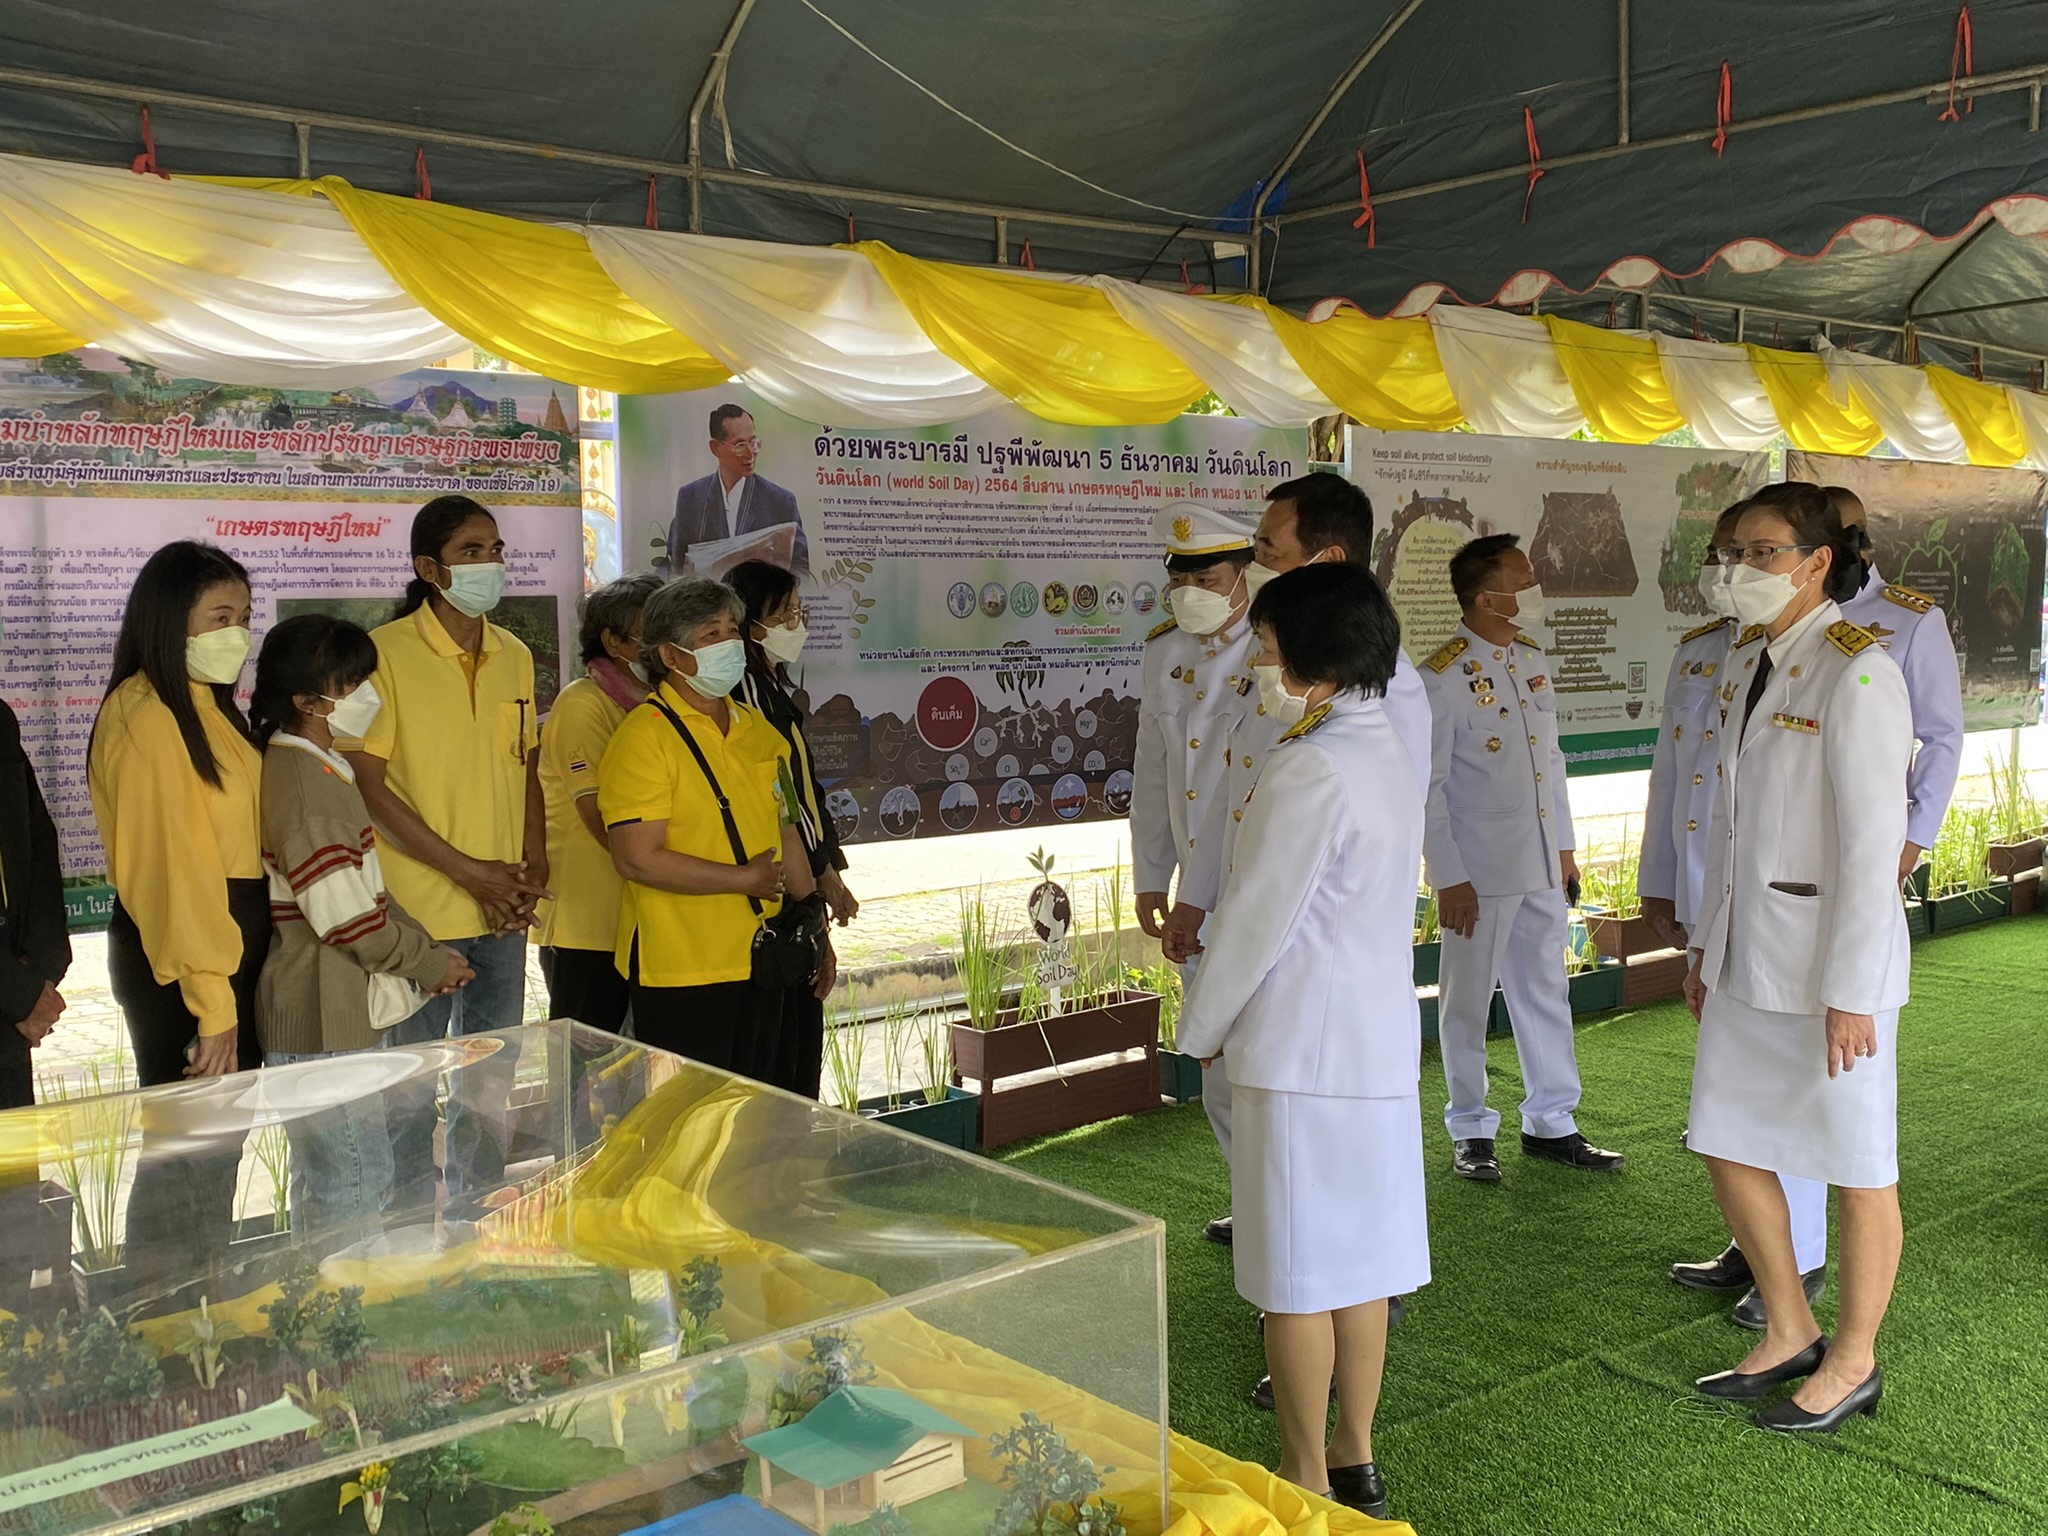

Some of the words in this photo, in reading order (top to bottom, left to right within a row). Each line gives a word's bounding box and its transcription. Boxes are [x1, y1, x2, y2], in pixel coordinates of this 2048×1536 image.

[814, 425, 969, 463] ด้วยพระบารมี
[977, 437, 1091, 474] ปฐพีพัฒนา
[1100, 450, 1112, 470] 5
[1120, 445, 1199, 473] ธันวาคม
[1205, 449, 1292, 477] วันดินโลก
[1372, 448, 1388, 459] Keep
[1391, 449, 1401, 459] soil
[1422, 452, 1444, 461] protect
[1446, 452, 1456, 461] soil
[1458, 453, 1492, 464] biodiversity
[541, 478, 560, 492] 19)
[816, 466, 881, 488] วันดินโลก
[887, 471, 924, 492] (world
[928, 474, 950, 490] Soil
[953, 474, 980, 495] Day)
[985, 477, 1018, 493] 2564
[1023, 476, 1064, 494] สืบสาน
[1165, 486, 1186, 499] และ
[1189, 481, 1208, 499] โคก
[1212, 488, 1240, 500] หนอง
[1244, 489, 1257, 500] นา
[376, 550, 385, 559] 16
[31, 565, 54, 575] 2537
[921, 663, 936, 673] และ
[31, 700, 38, 708] 4
[931, 705, 963, 721] ดินเค็ม
[1037, 940, 1071, 964] World
[1036, 965, 1057, 985] Soil
[1059, 963, 1078, 982] Day
